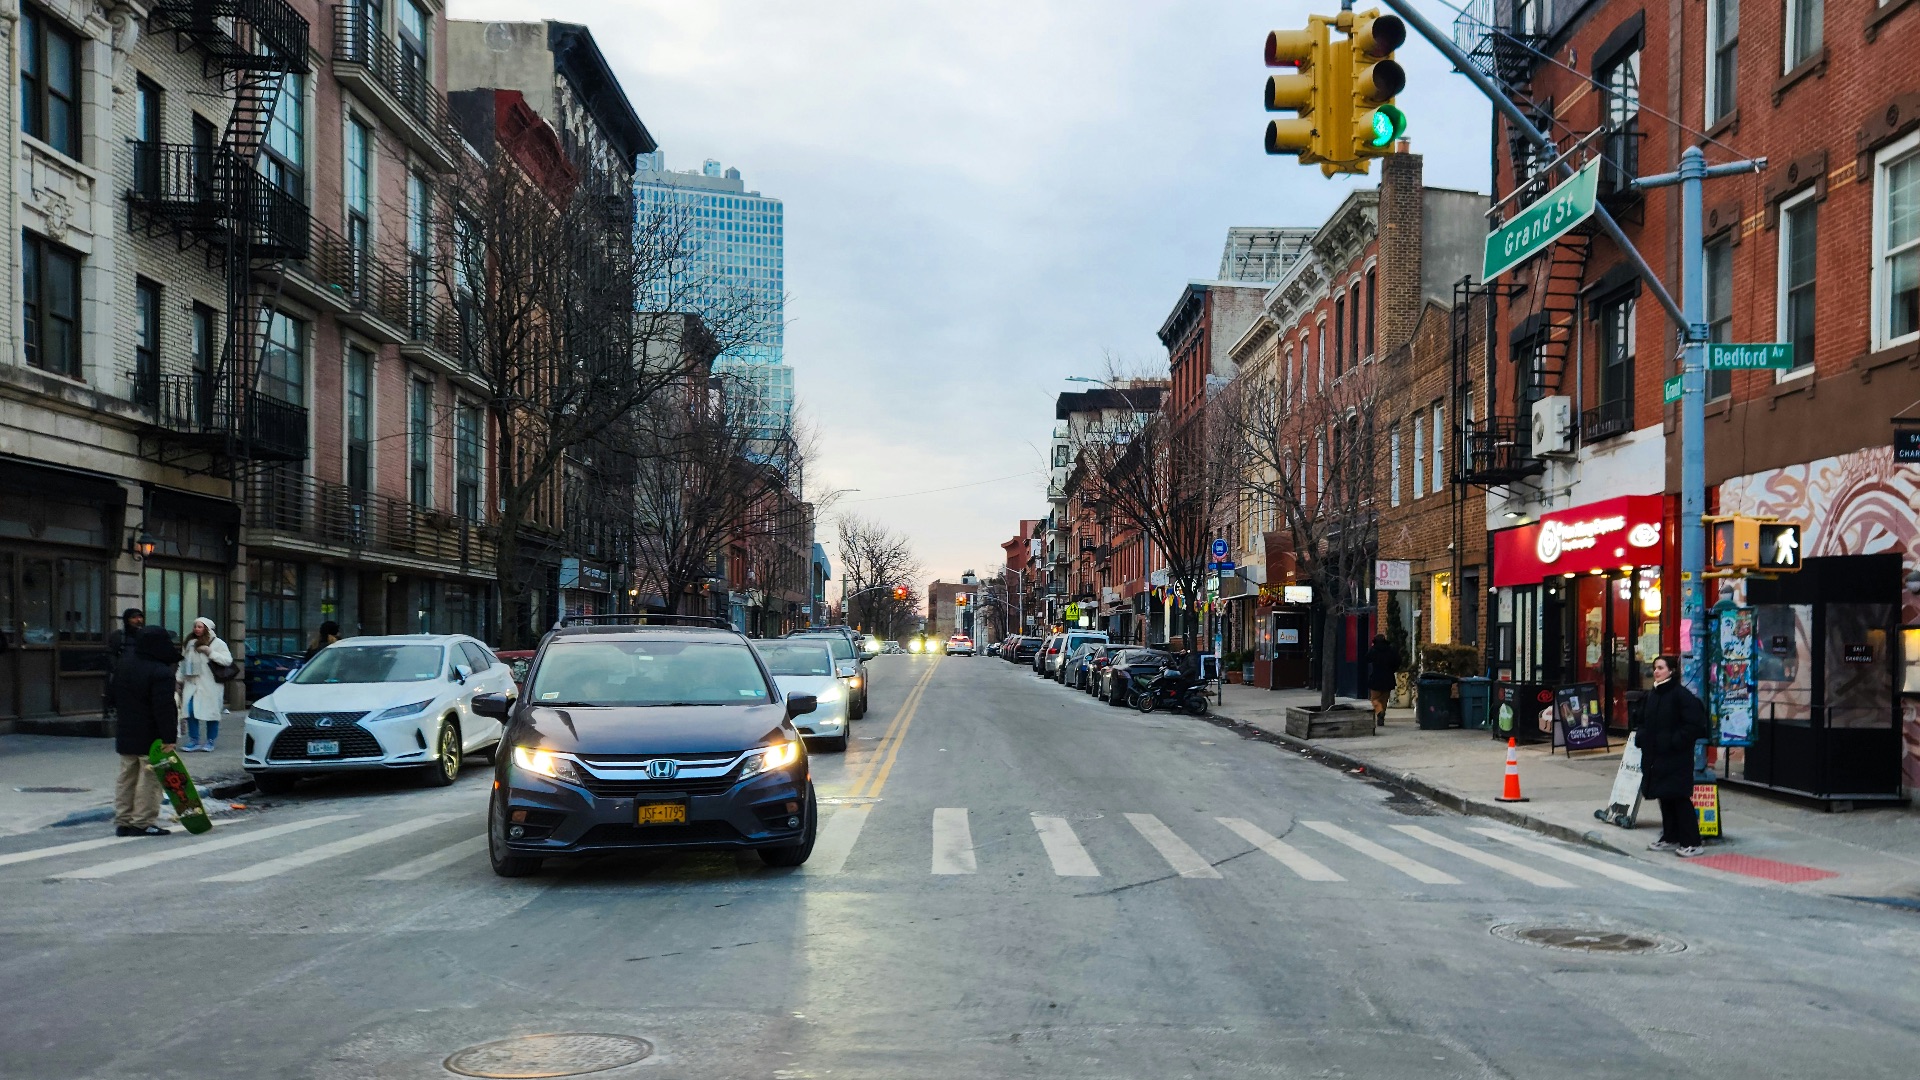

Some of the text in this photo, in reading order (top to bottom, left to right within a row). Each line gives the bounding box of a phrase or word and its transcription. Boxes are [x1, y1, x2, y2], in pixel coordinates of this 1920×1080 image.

[1504, 190, 1574, 257] Grand St
[1714, 345, 1784, 367] Bedford Av
[1665, 378, 1681, 401] Grand
